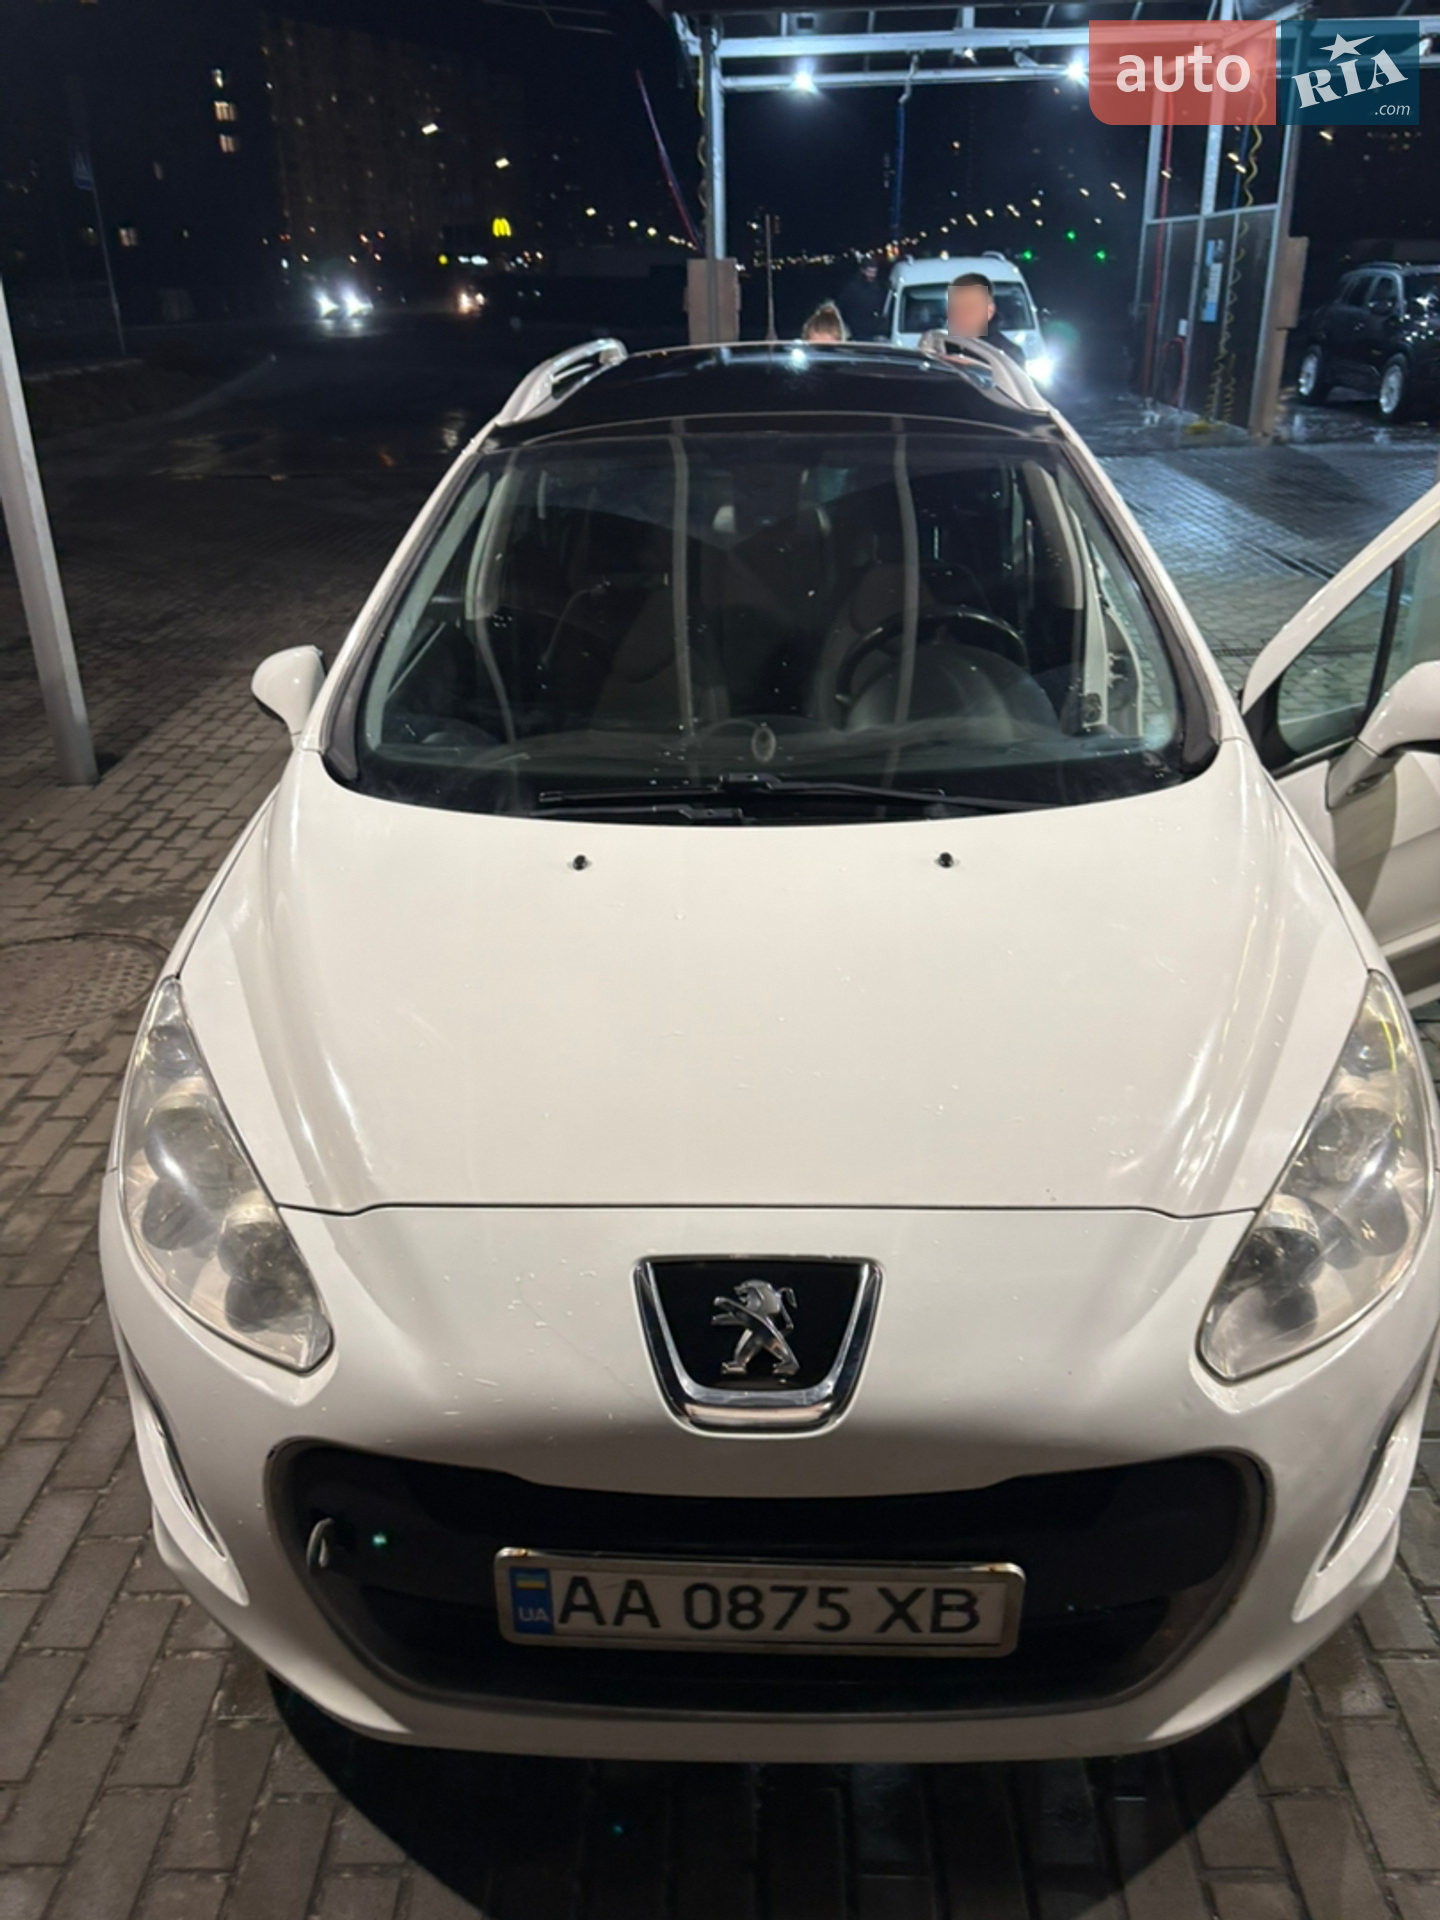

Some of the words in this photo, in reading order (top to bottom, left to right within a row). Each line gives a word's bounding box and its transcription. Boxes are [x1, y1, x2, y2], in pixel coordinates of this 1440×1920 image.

[518, 1606, 549, 1623] UA
[558, 1575, 660, 1628] AA
[683, 1582, 851, 1632] 0875
[874, 1586, 981, 1634] XB
